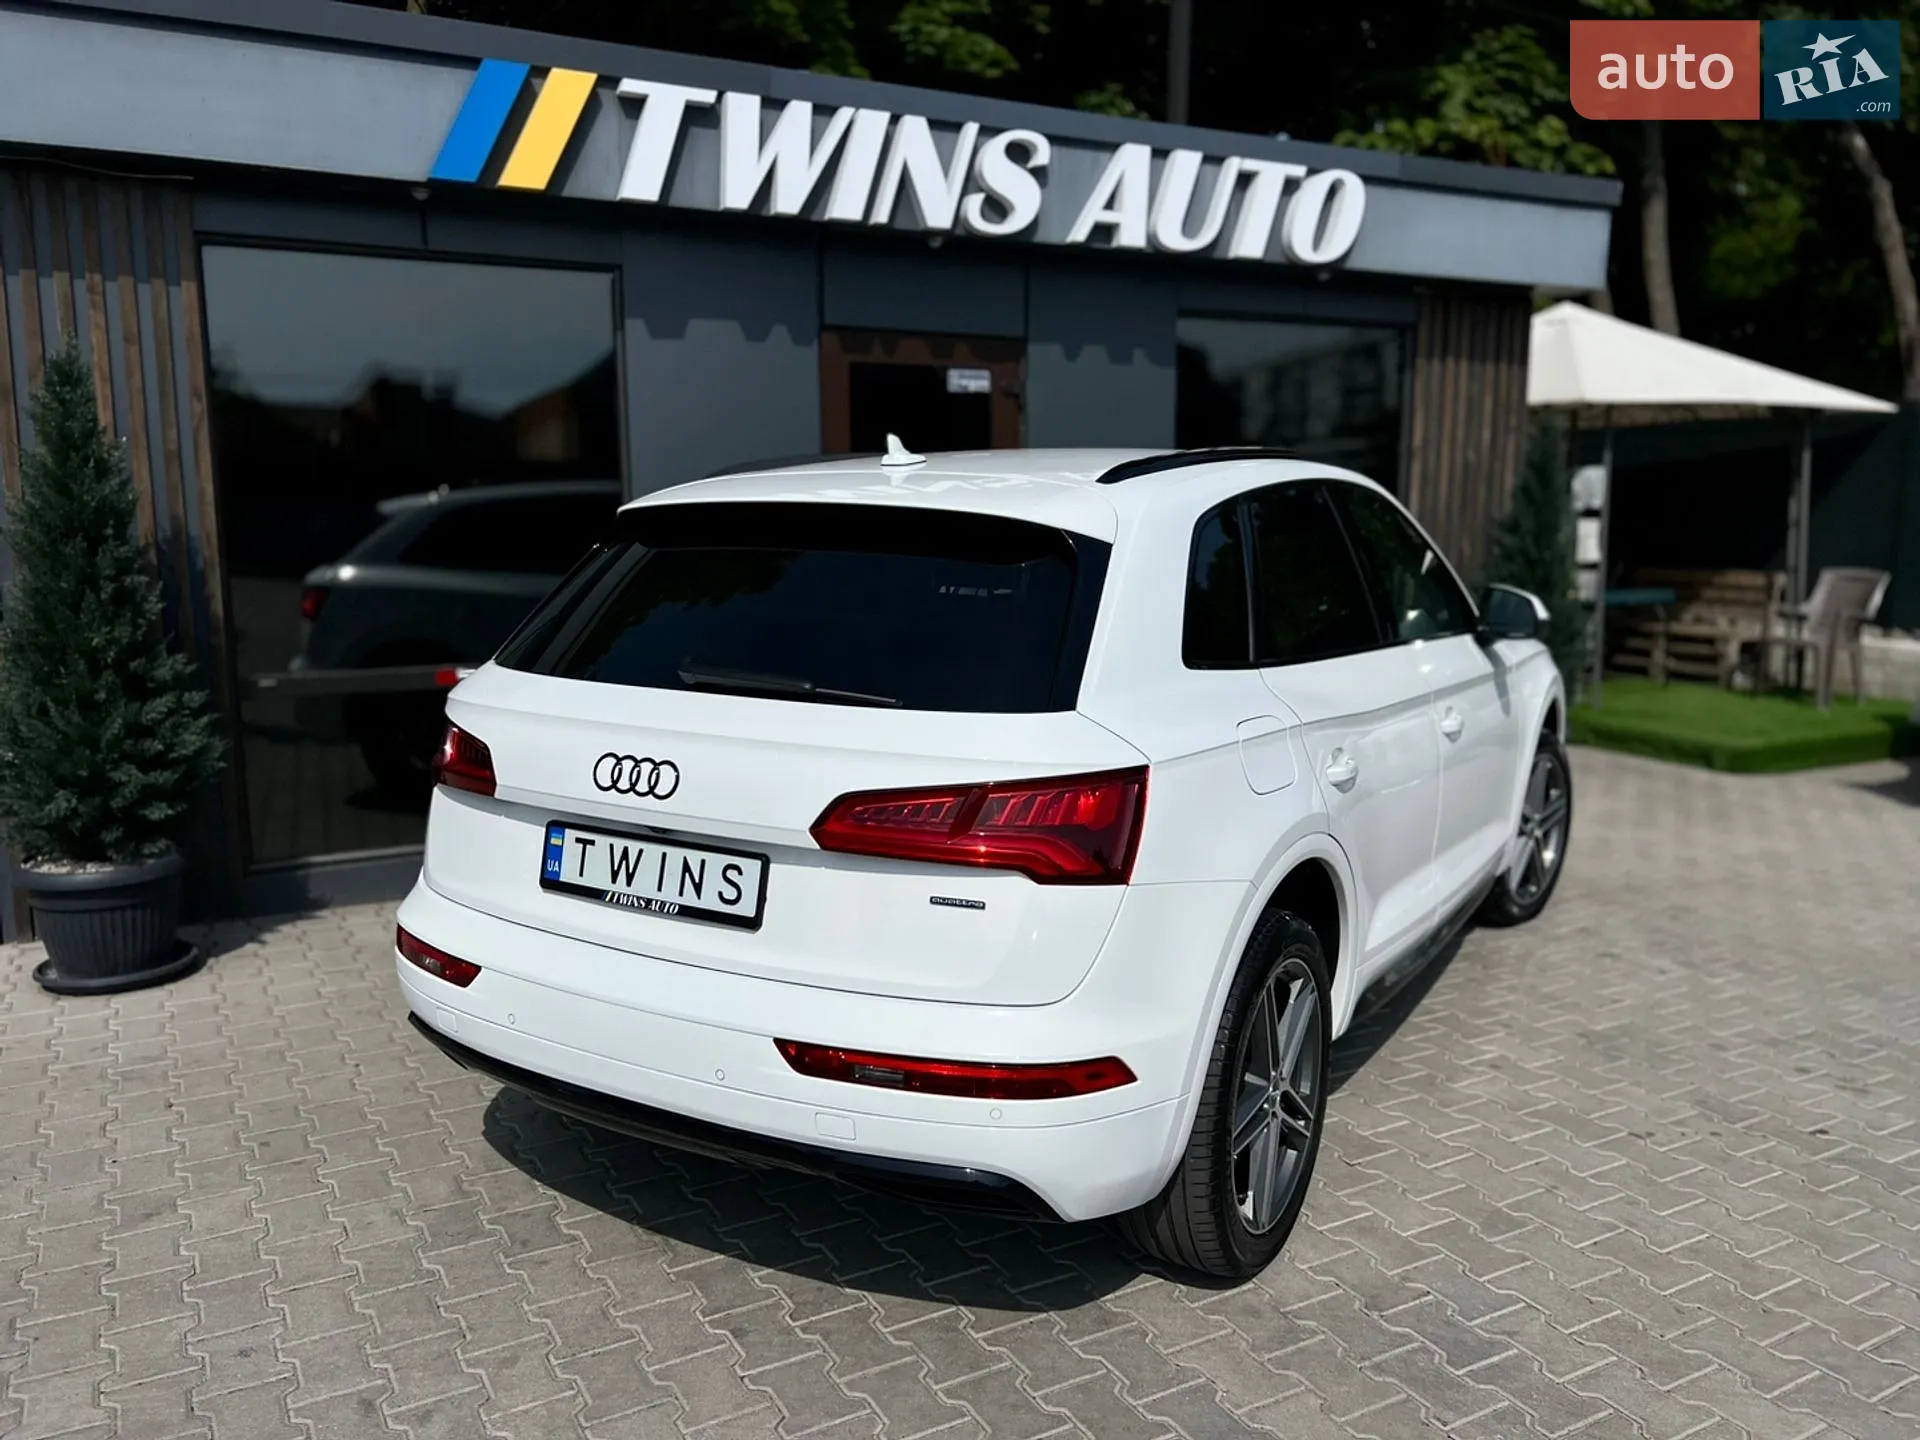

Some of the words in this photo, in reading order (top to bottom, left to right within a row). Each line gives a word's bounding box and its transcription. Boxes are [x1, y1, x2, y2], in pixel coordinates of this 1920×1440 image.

[615, 77, 1050, 237] TWINS
[1065, 142, 1366, 264] AUTO
[547, 859, 560, 873] UA
[613, 892, 647, 907] TWINS
[650, 899, 679, 914] AUTO
